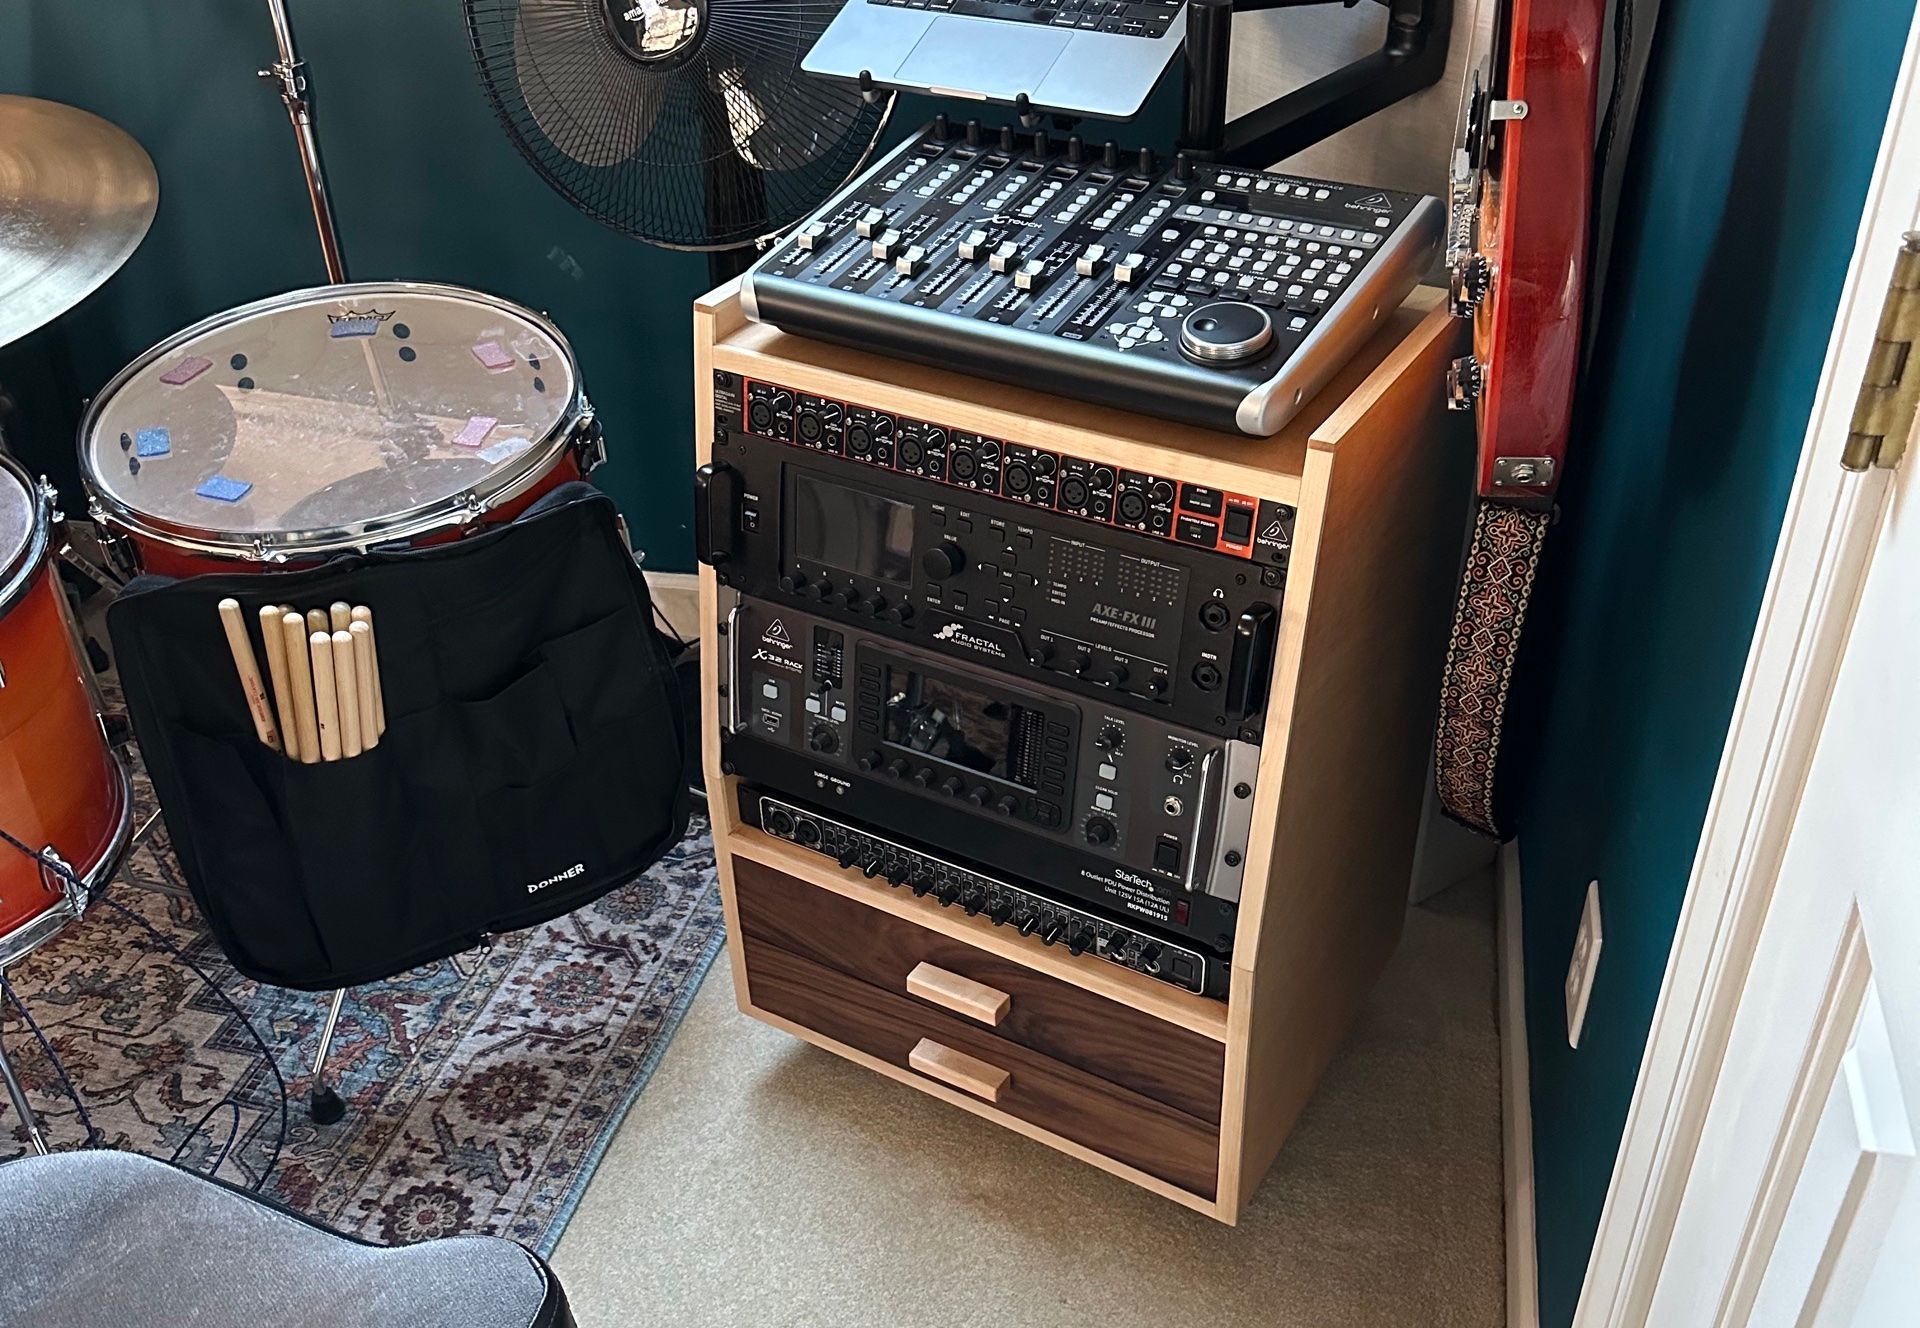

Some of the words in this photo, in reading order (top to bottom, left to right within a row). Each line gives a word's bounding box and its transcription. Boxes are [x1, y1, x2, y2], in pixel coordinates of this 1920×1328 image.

[1344, 203, 1393, 214] behringer
[1007, 219, 1043, 229] TOUCH
[1256, 537, 1290, 550] behringer
[1140, 558, 1160, 567] OUTPUT
[1092, 602, 1140, 625] AXE-FX
[1140, 616, 1156, 630] III
[762, 634, 793, 650] behringer
[950, 638, 972, 648] AUDIO
[974, 645, 1006, 658] SYSTEMS
[956, 632, 1001, 652] FRACTAL
[784, 659, 804, 670] RACK
[830, 776, 850, 788] GROUND
[527, 864, 585, 894] DONNER
[1086, 872, 1104, 882] Outlet
[1104, 878, 1118, 888] PDU
[1118, 882, 1136, 894] Power
[1136, 887, 1170, 906] Distribution
[1104, 886, 1117, 895] Unit
[1118, 890, 1132, 900] 125V
[1133, 896, 1144, 904] 15A
[1144, 899, 1159, 910] (12A
[1159, 904, 1170, 914] UL)
[1127, 902, 1168, 922] RKPW081915
